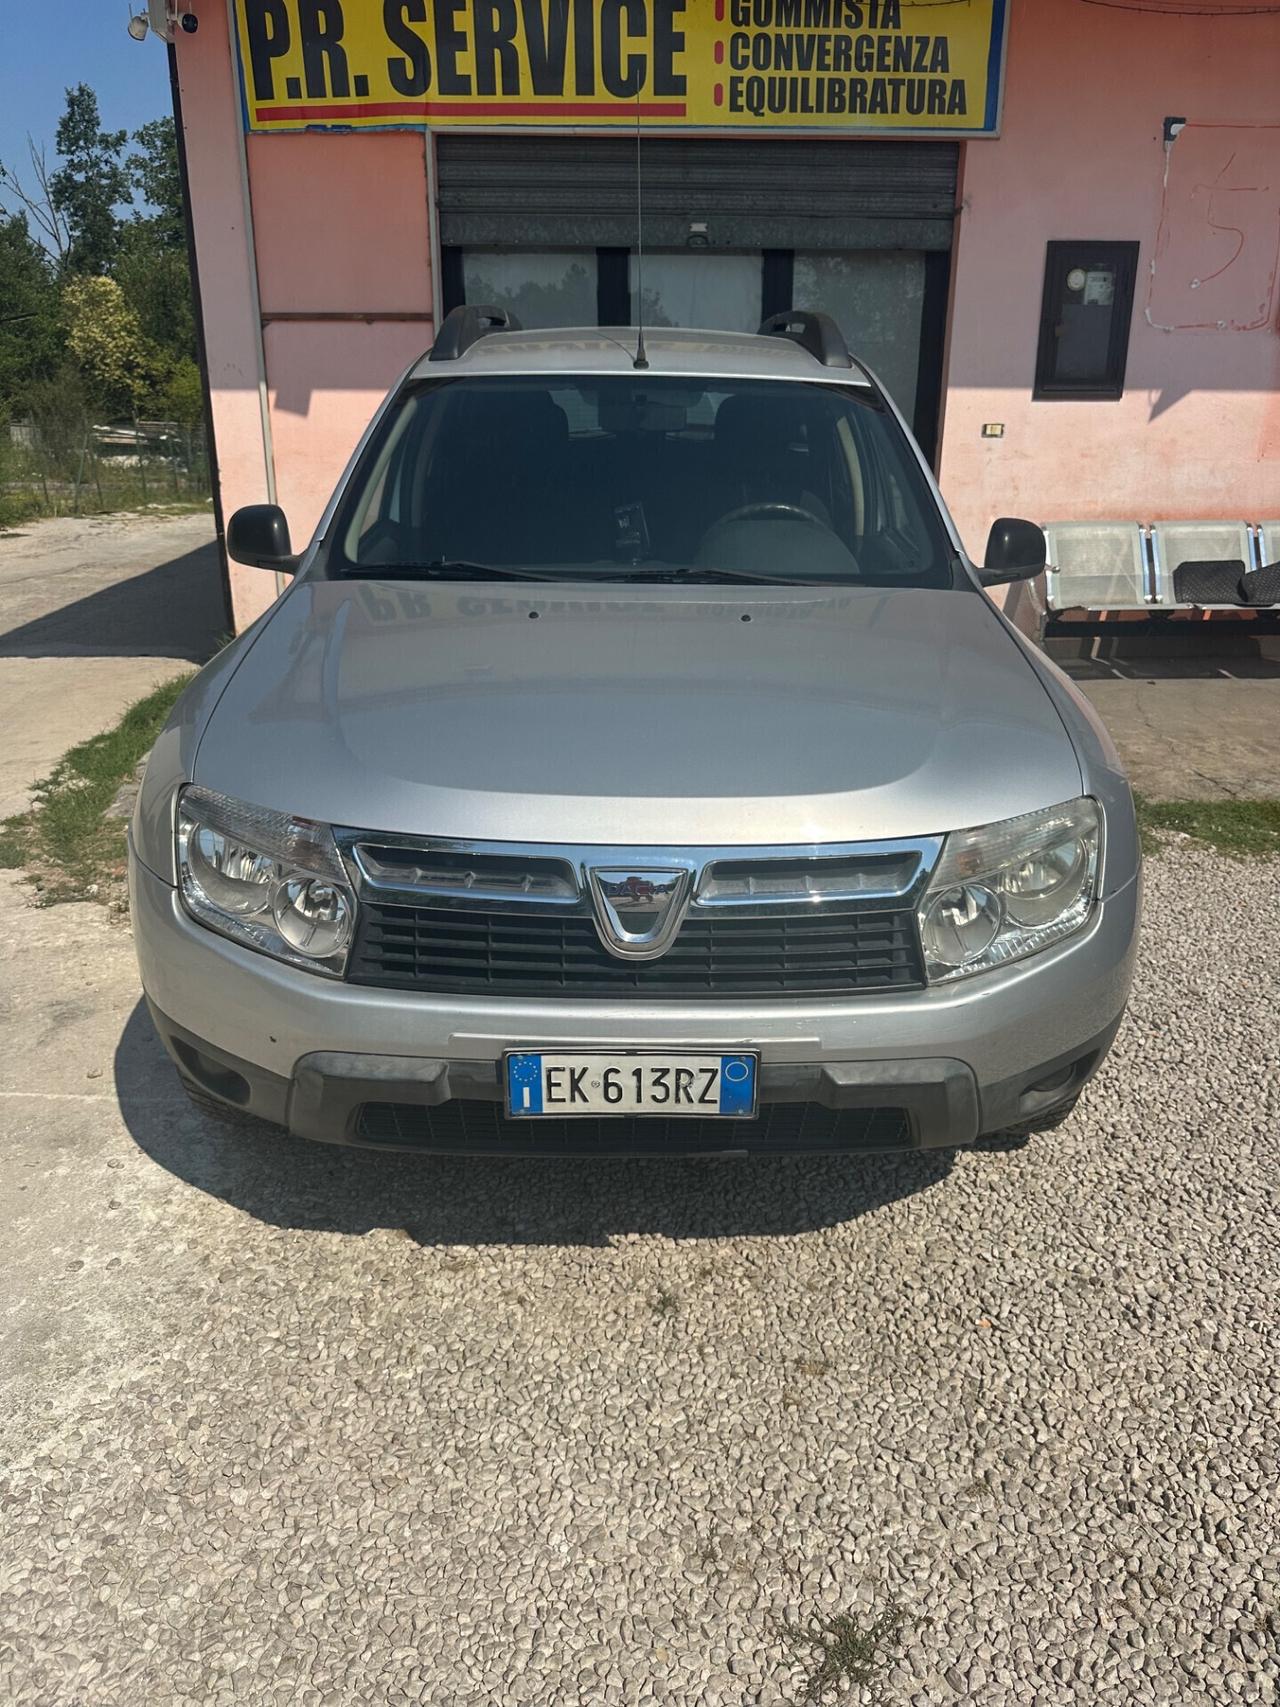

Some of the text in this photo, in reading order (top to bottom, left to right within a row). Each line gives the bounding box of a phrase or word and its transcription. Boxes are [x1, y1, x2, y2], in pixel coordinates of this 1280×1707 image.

[246, 0, 687, 100] P.R. SERVICE
[729, 32, 950, 73] CONVERGENZA
[729, 76, 967, 117] EQUILIBRATURA
